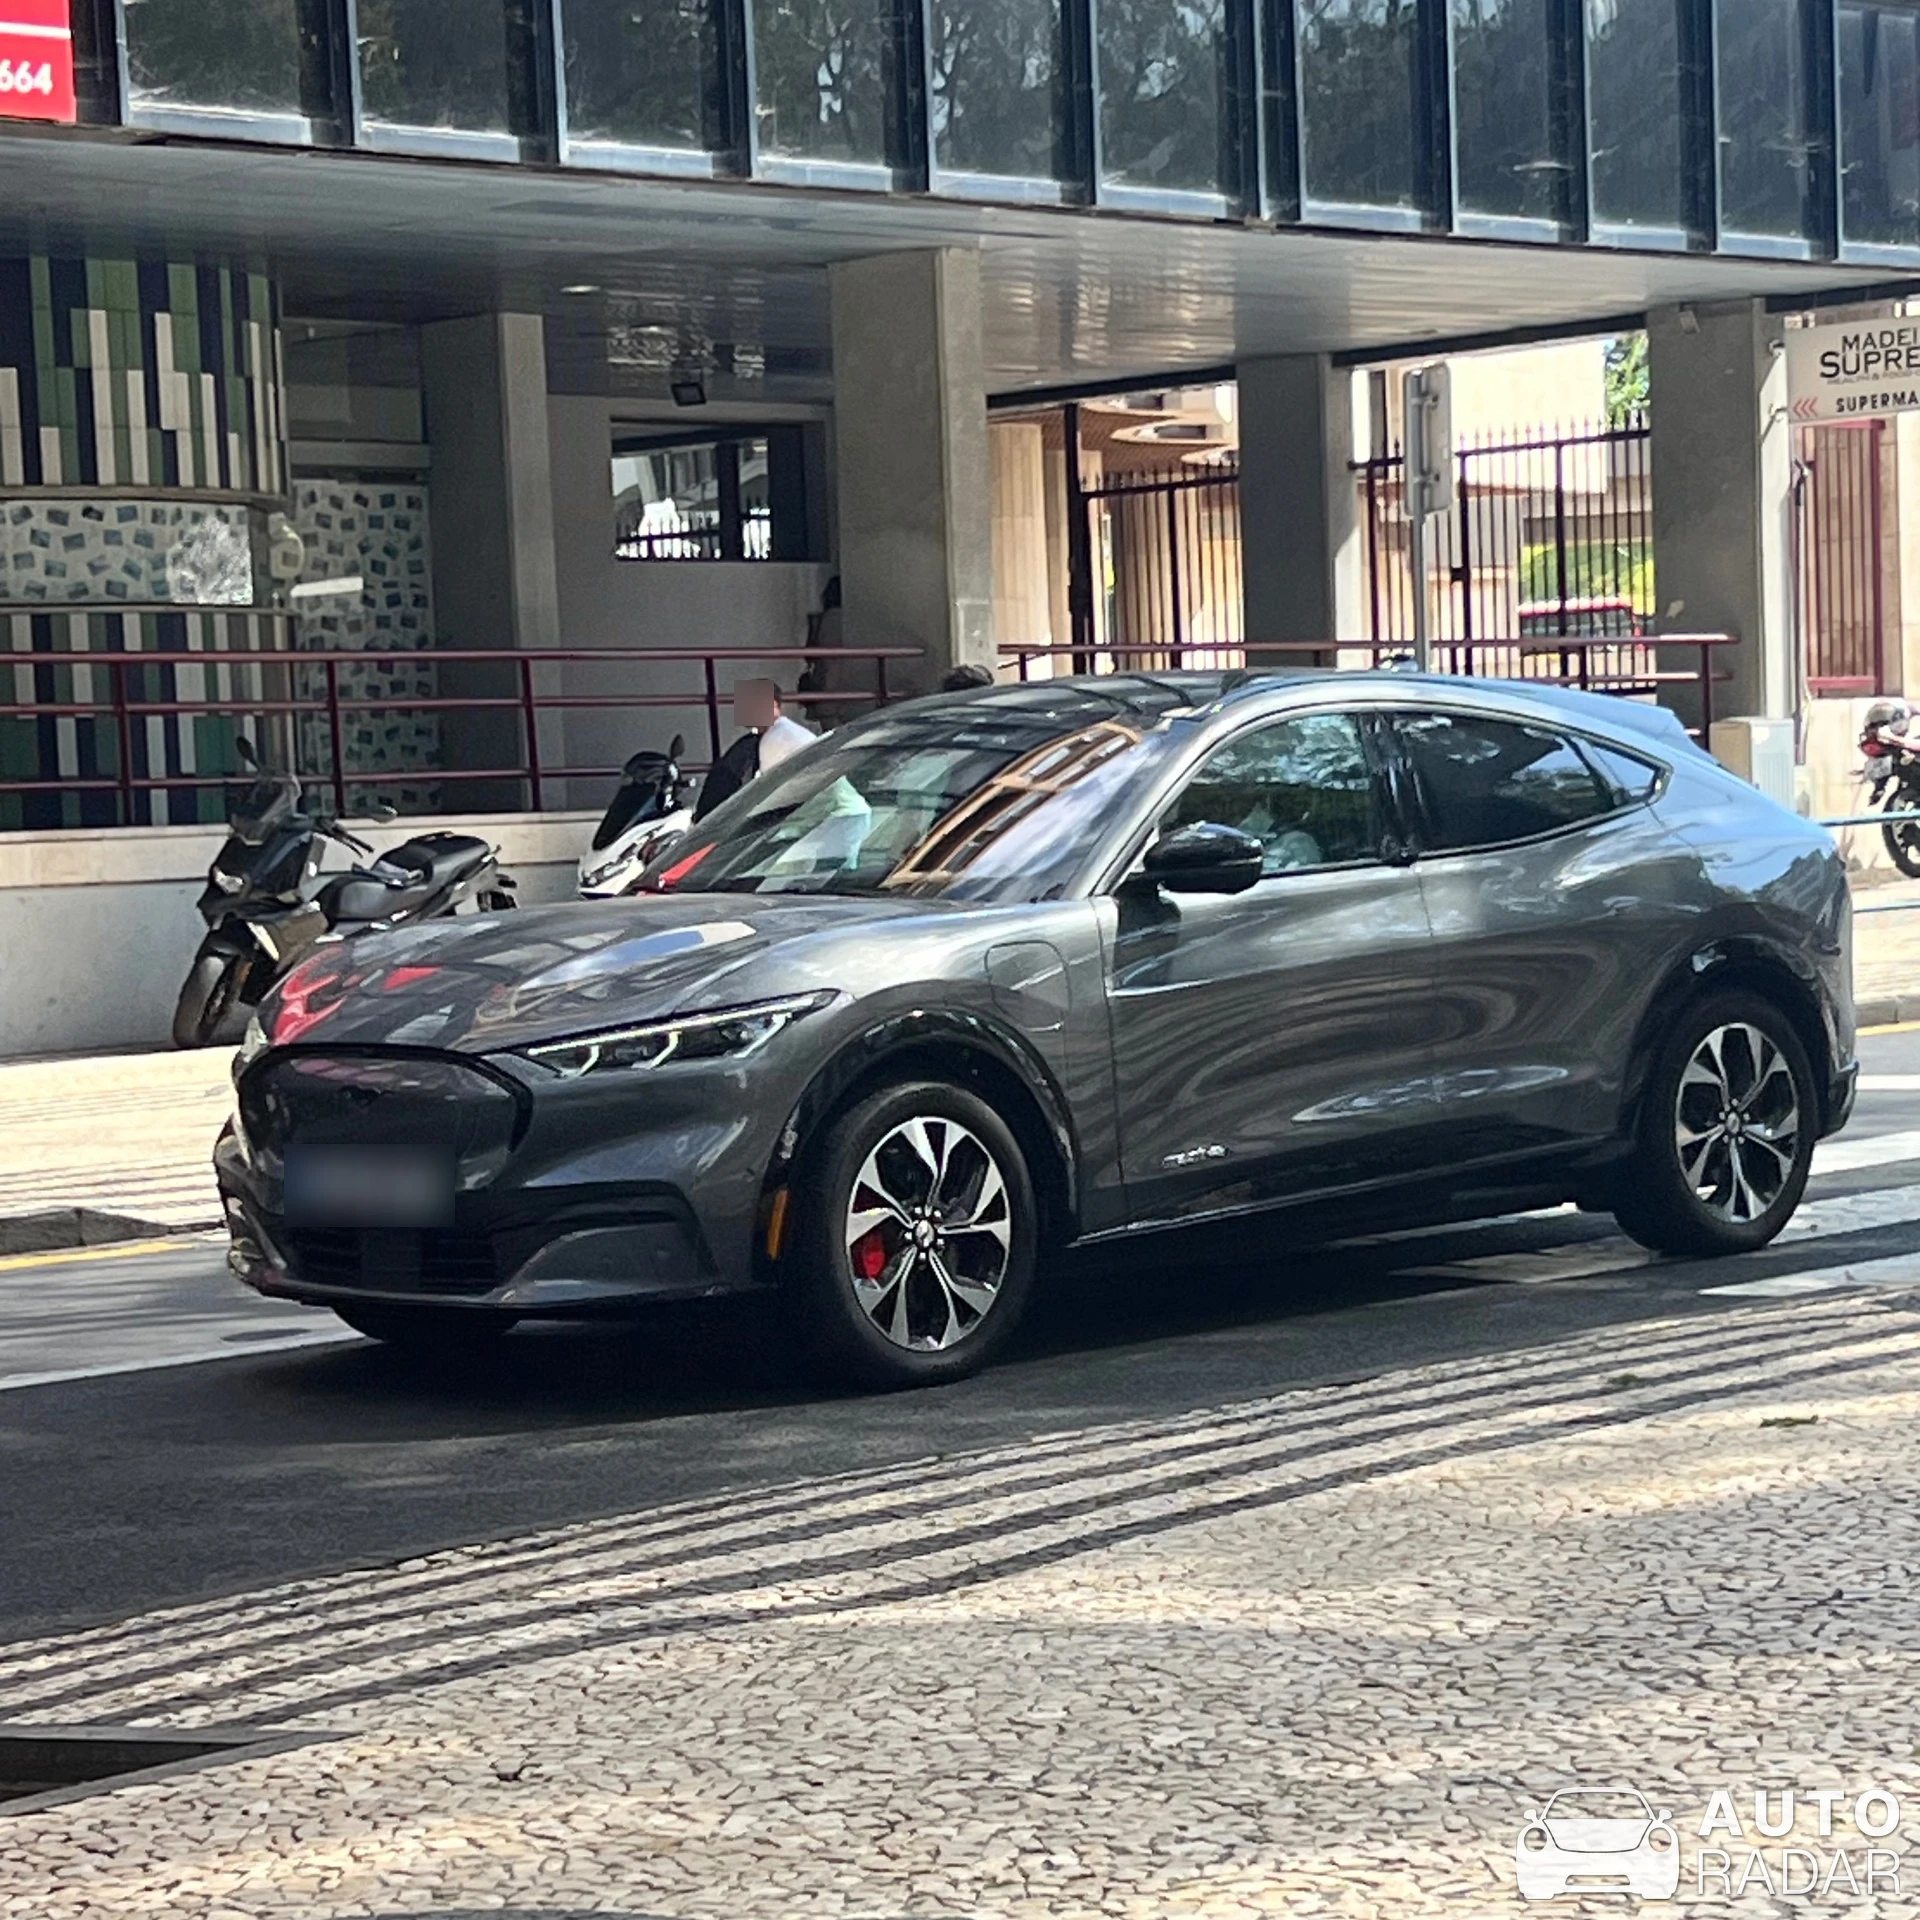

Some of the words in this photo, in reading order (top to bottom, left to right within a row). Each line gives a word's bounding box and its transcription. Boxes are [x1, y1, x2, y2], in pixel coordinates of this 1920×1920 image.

[1841, 327, 1918, 354] MADEI
[1819, 346, 1920, 379] SUPRE
[1836, 390, 1919, 413] SUPERMA
